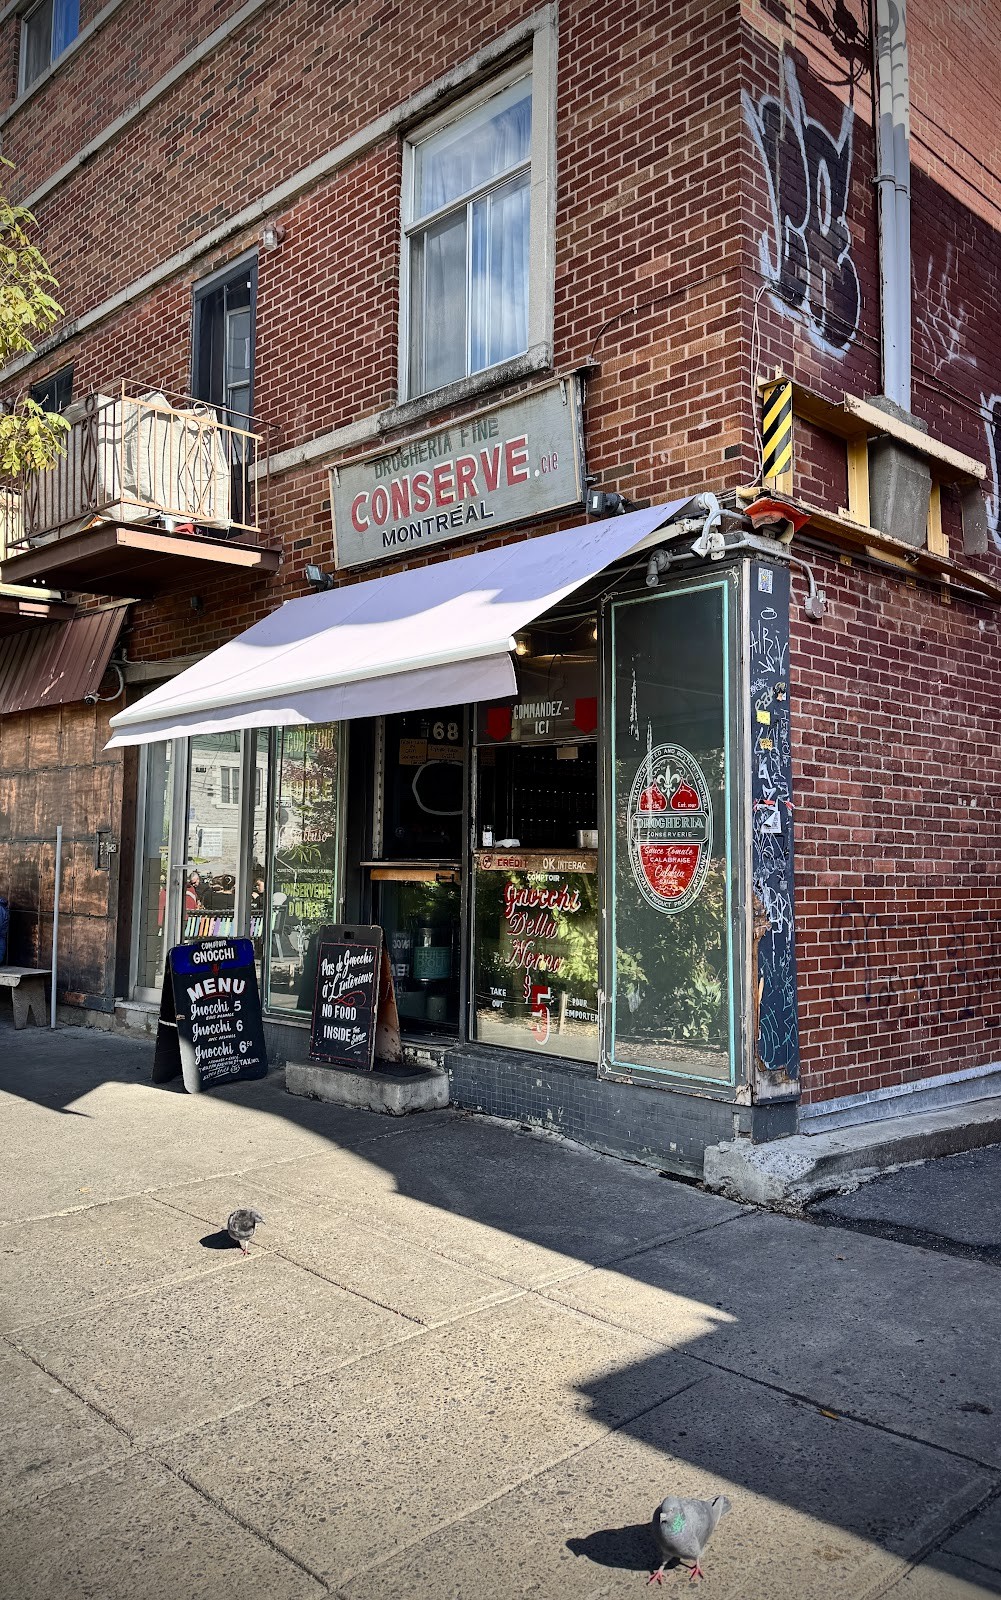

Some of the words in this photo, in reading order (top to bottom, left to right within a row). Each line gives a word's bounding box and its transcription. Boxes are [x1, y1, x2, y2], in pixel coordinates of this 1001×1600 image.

[374, 431, 453, 480] DROGHERIA
[460, 417, 500, 448] FINE
[382, 500, 495, 547] MONTRÉAL
[432, 721, 459, 740] 68
[535, 720, 549, 734] ICI
[635, 816, 705, 829] DROGHERIA
[542, 858, 555, 869] OK
[557, 861, 587, 870] INTERAC
[526, 874, 560, 882] COMPTOIR
[506, 911, 559, 939] Della
[192, 947, 235, 964] GNOCCHI
[321, 958, 335, 976] Pas
[336, 954, 343, 972] de
[341, 948, 374, 979] Gnocchi
[187, 977, 246, 1004] MENU
[490, 987, 507, 997] TAKE
[233, 1000, 242, 1012] 5
[321, 1003, 333, 1017] NO
[334, 1005, 357, 1021] FOOD
[491, 1000, 504, 1009] OUT
[236, 1020, 244, 1032] 6
[323, 1024, 352, 1042] INSIDE
